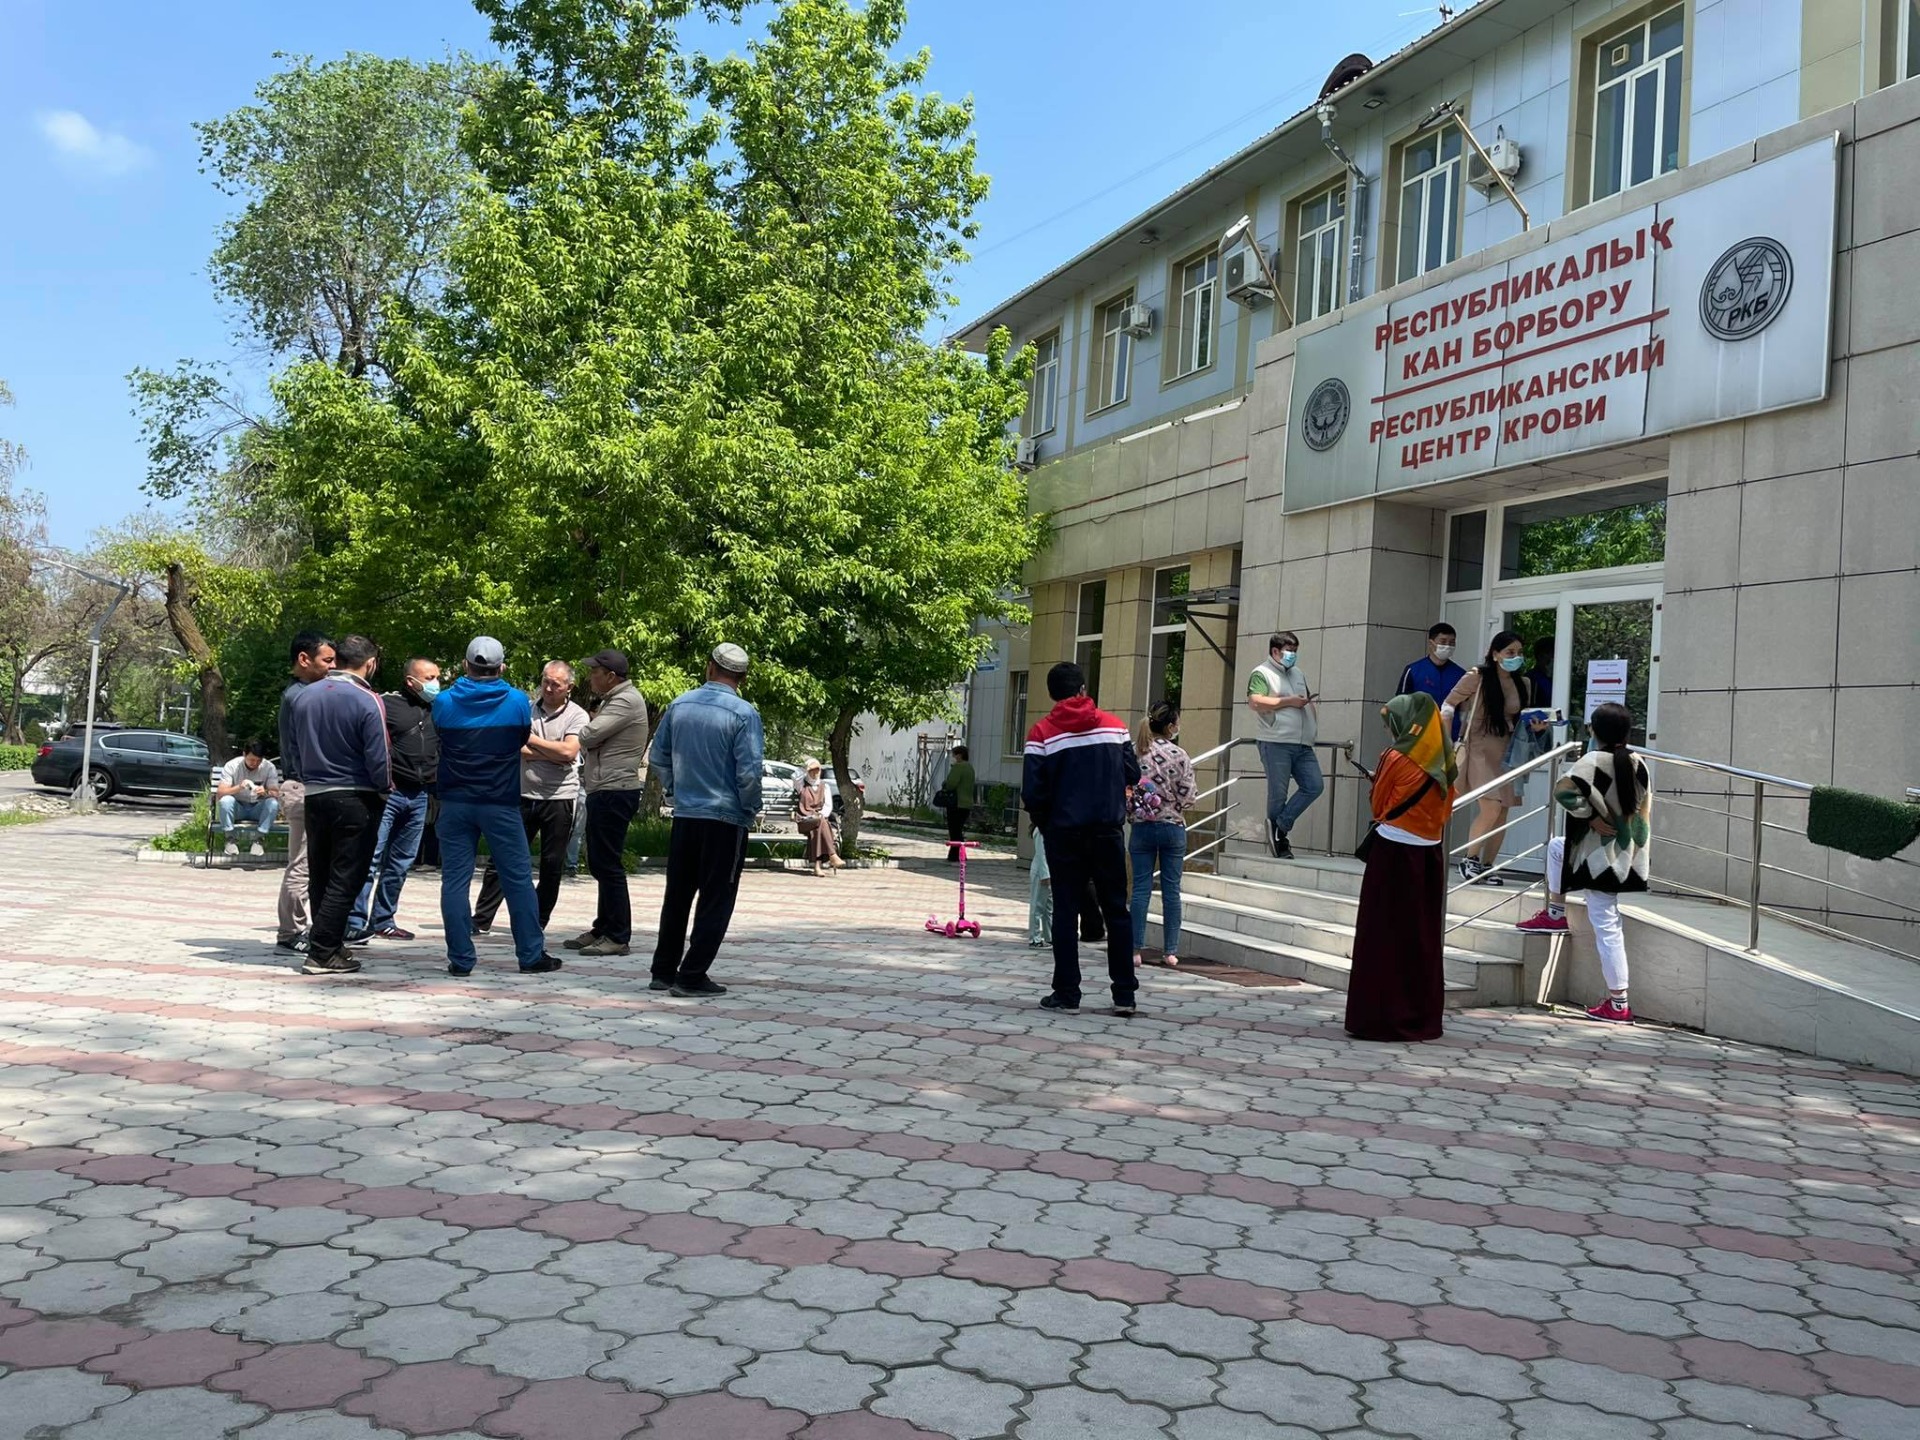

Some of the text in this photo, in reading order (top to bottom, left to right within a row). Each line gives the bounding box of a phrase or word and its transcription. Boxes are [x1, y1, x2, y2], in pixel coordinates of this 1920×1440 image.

[1375, 218, 1674, 351] РЕСПУБЛИКАЛЫК
[1727, 291, 1769, 329] РКБ
[1403, 279, 1633, 380] КАН БОРБОРУ
[1370, 334, 1665, 444] РЕСПУБЛИКАНСКИЙ
[1401, 395, 1607, 469] ЦЕНТР КРОВИ
[294, 941, 307, 951] N
